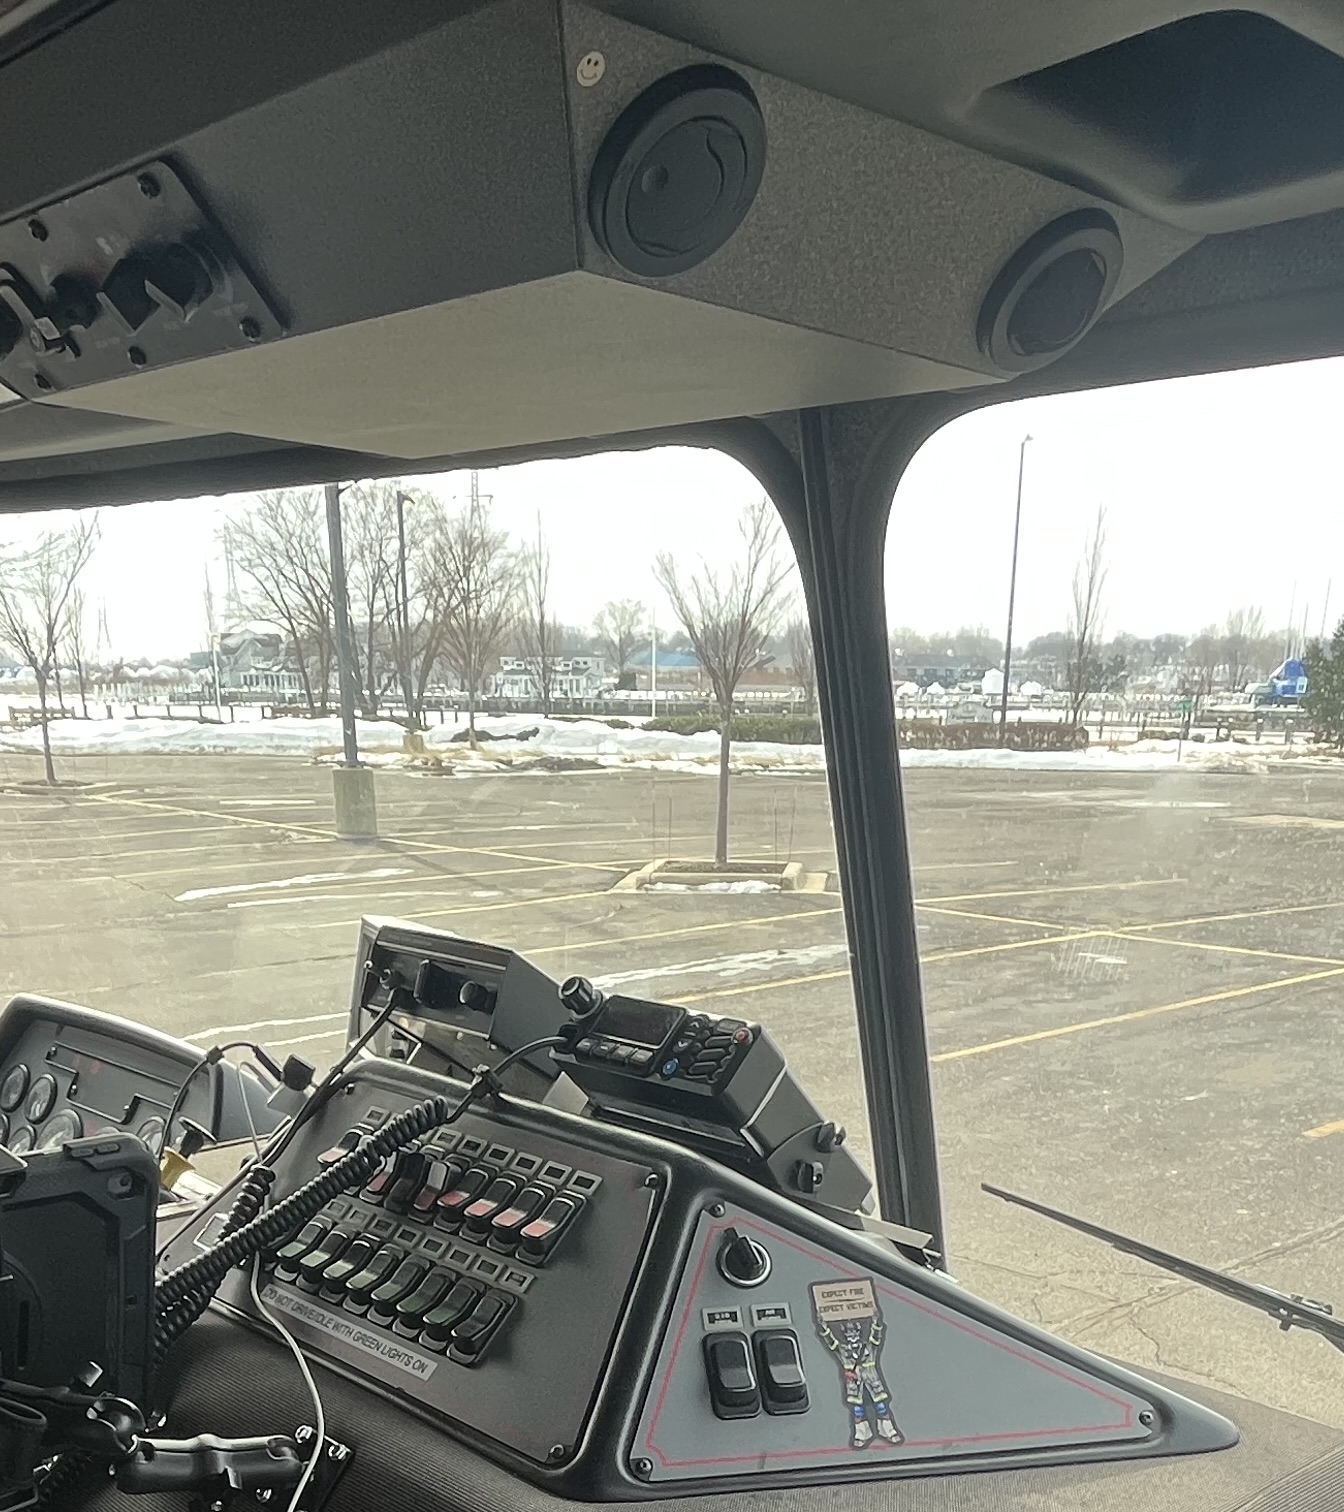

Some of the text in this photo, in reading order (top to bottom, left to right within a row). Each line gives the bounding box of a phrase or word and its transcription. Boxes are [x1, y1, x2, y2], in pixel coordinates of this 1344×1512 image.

[332, 1321, 354, 1337] WITH
[353, 1331, 382, 1351] GREEN
[381, 1345, 413, 1366] LIGHTS
[412, 1359, 428, 1373] ON
